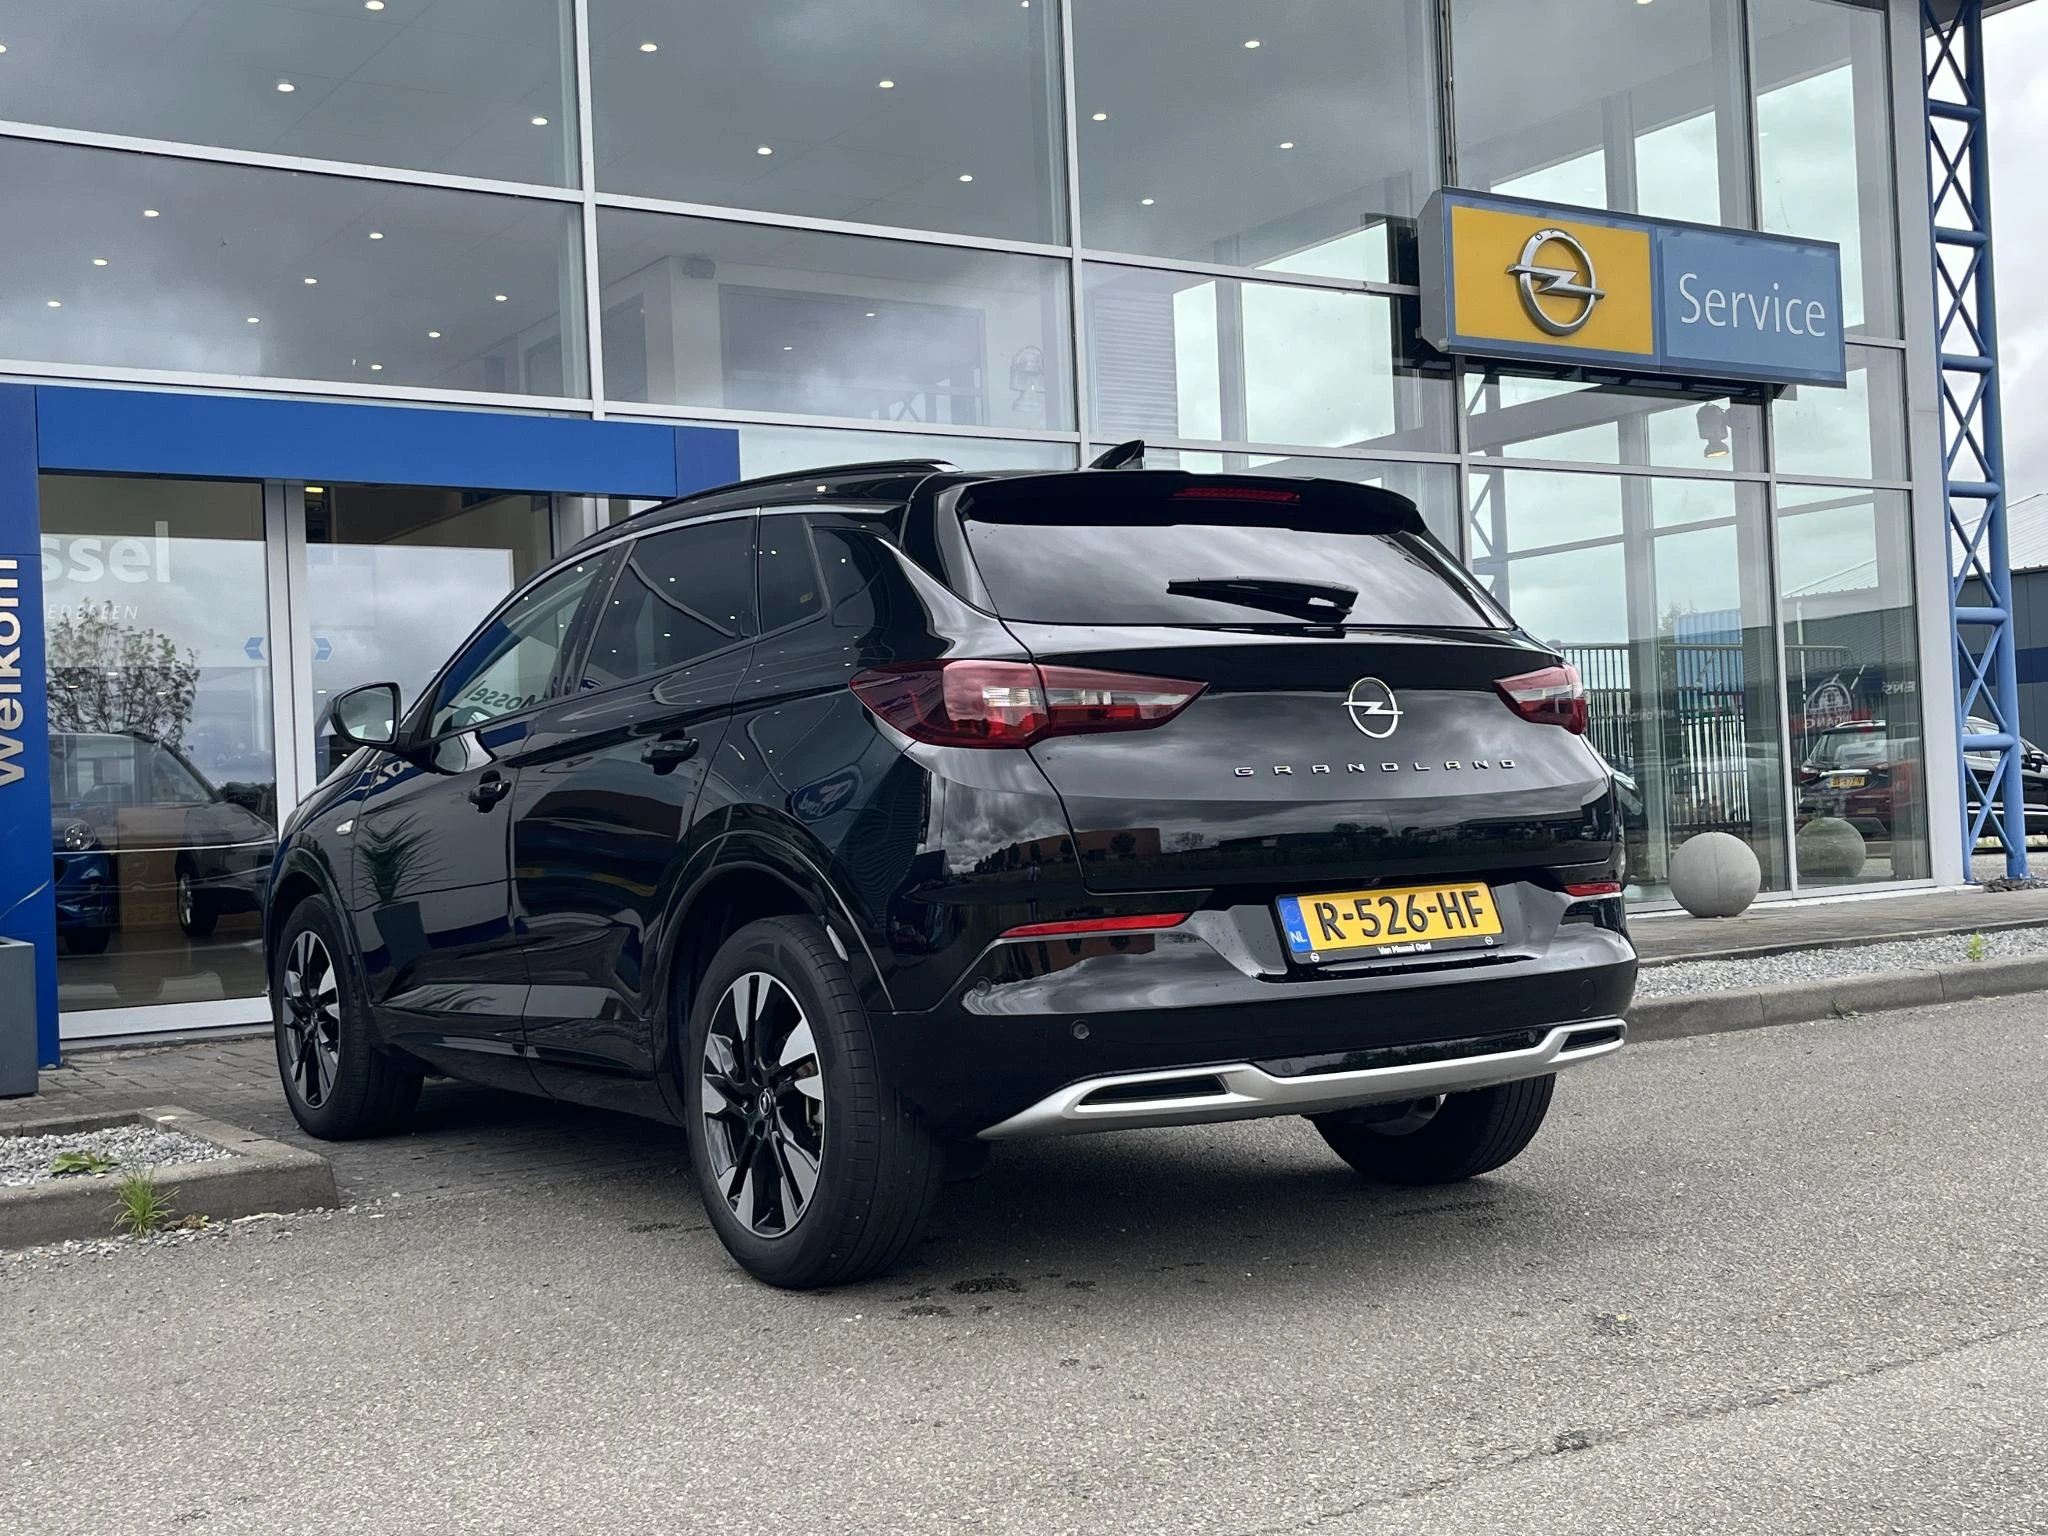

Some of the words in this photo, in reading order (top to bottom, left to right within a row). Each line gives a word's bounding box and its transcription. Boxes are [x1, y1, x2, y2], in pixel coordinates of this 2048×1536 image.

[1679, 273, 1826, 337] Service
[1234, 758, 1516, 777] GRANDLAND
[1314, 890, 1484, 941] R-526-HF
[1290, 930, 1307, 944] NL
[1377, 946, 1392, 955] Van
[1415, 942, 1432, 952] Opel
